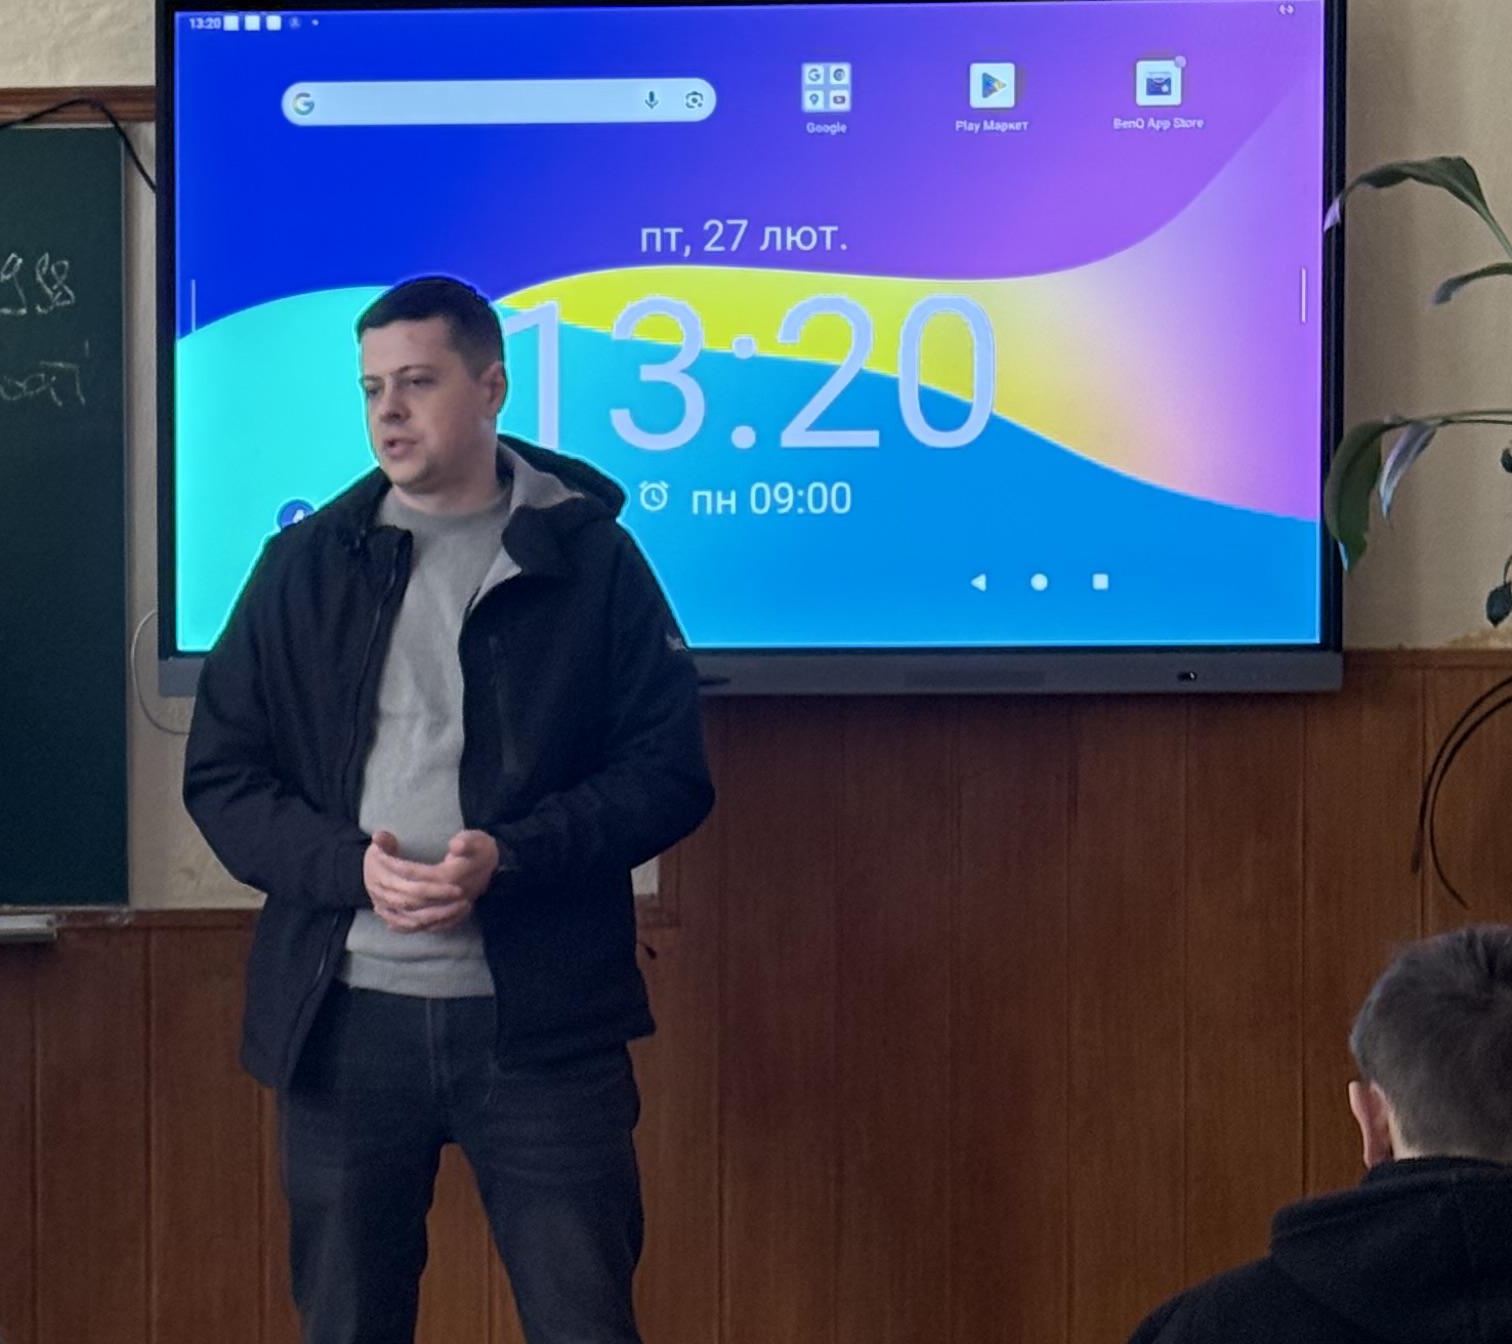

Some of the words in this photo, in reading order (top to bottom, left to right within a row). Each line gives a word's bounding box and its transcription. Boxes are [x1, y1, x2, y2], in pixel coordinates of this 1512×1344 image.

[806, 122, 847, 135] Google
[955, 120, 981, 134] Play
[983, 120, 1029, 133] Маркет
[641, 227, 691, 258] пт,
[703, 218, 749, 252] 27
[759, 226, 848, 252] лют.
[504, 293, 996, 451] 13:20
[691, 488, 737, 516] пн
[749, 480, 853, 516] 09:00
